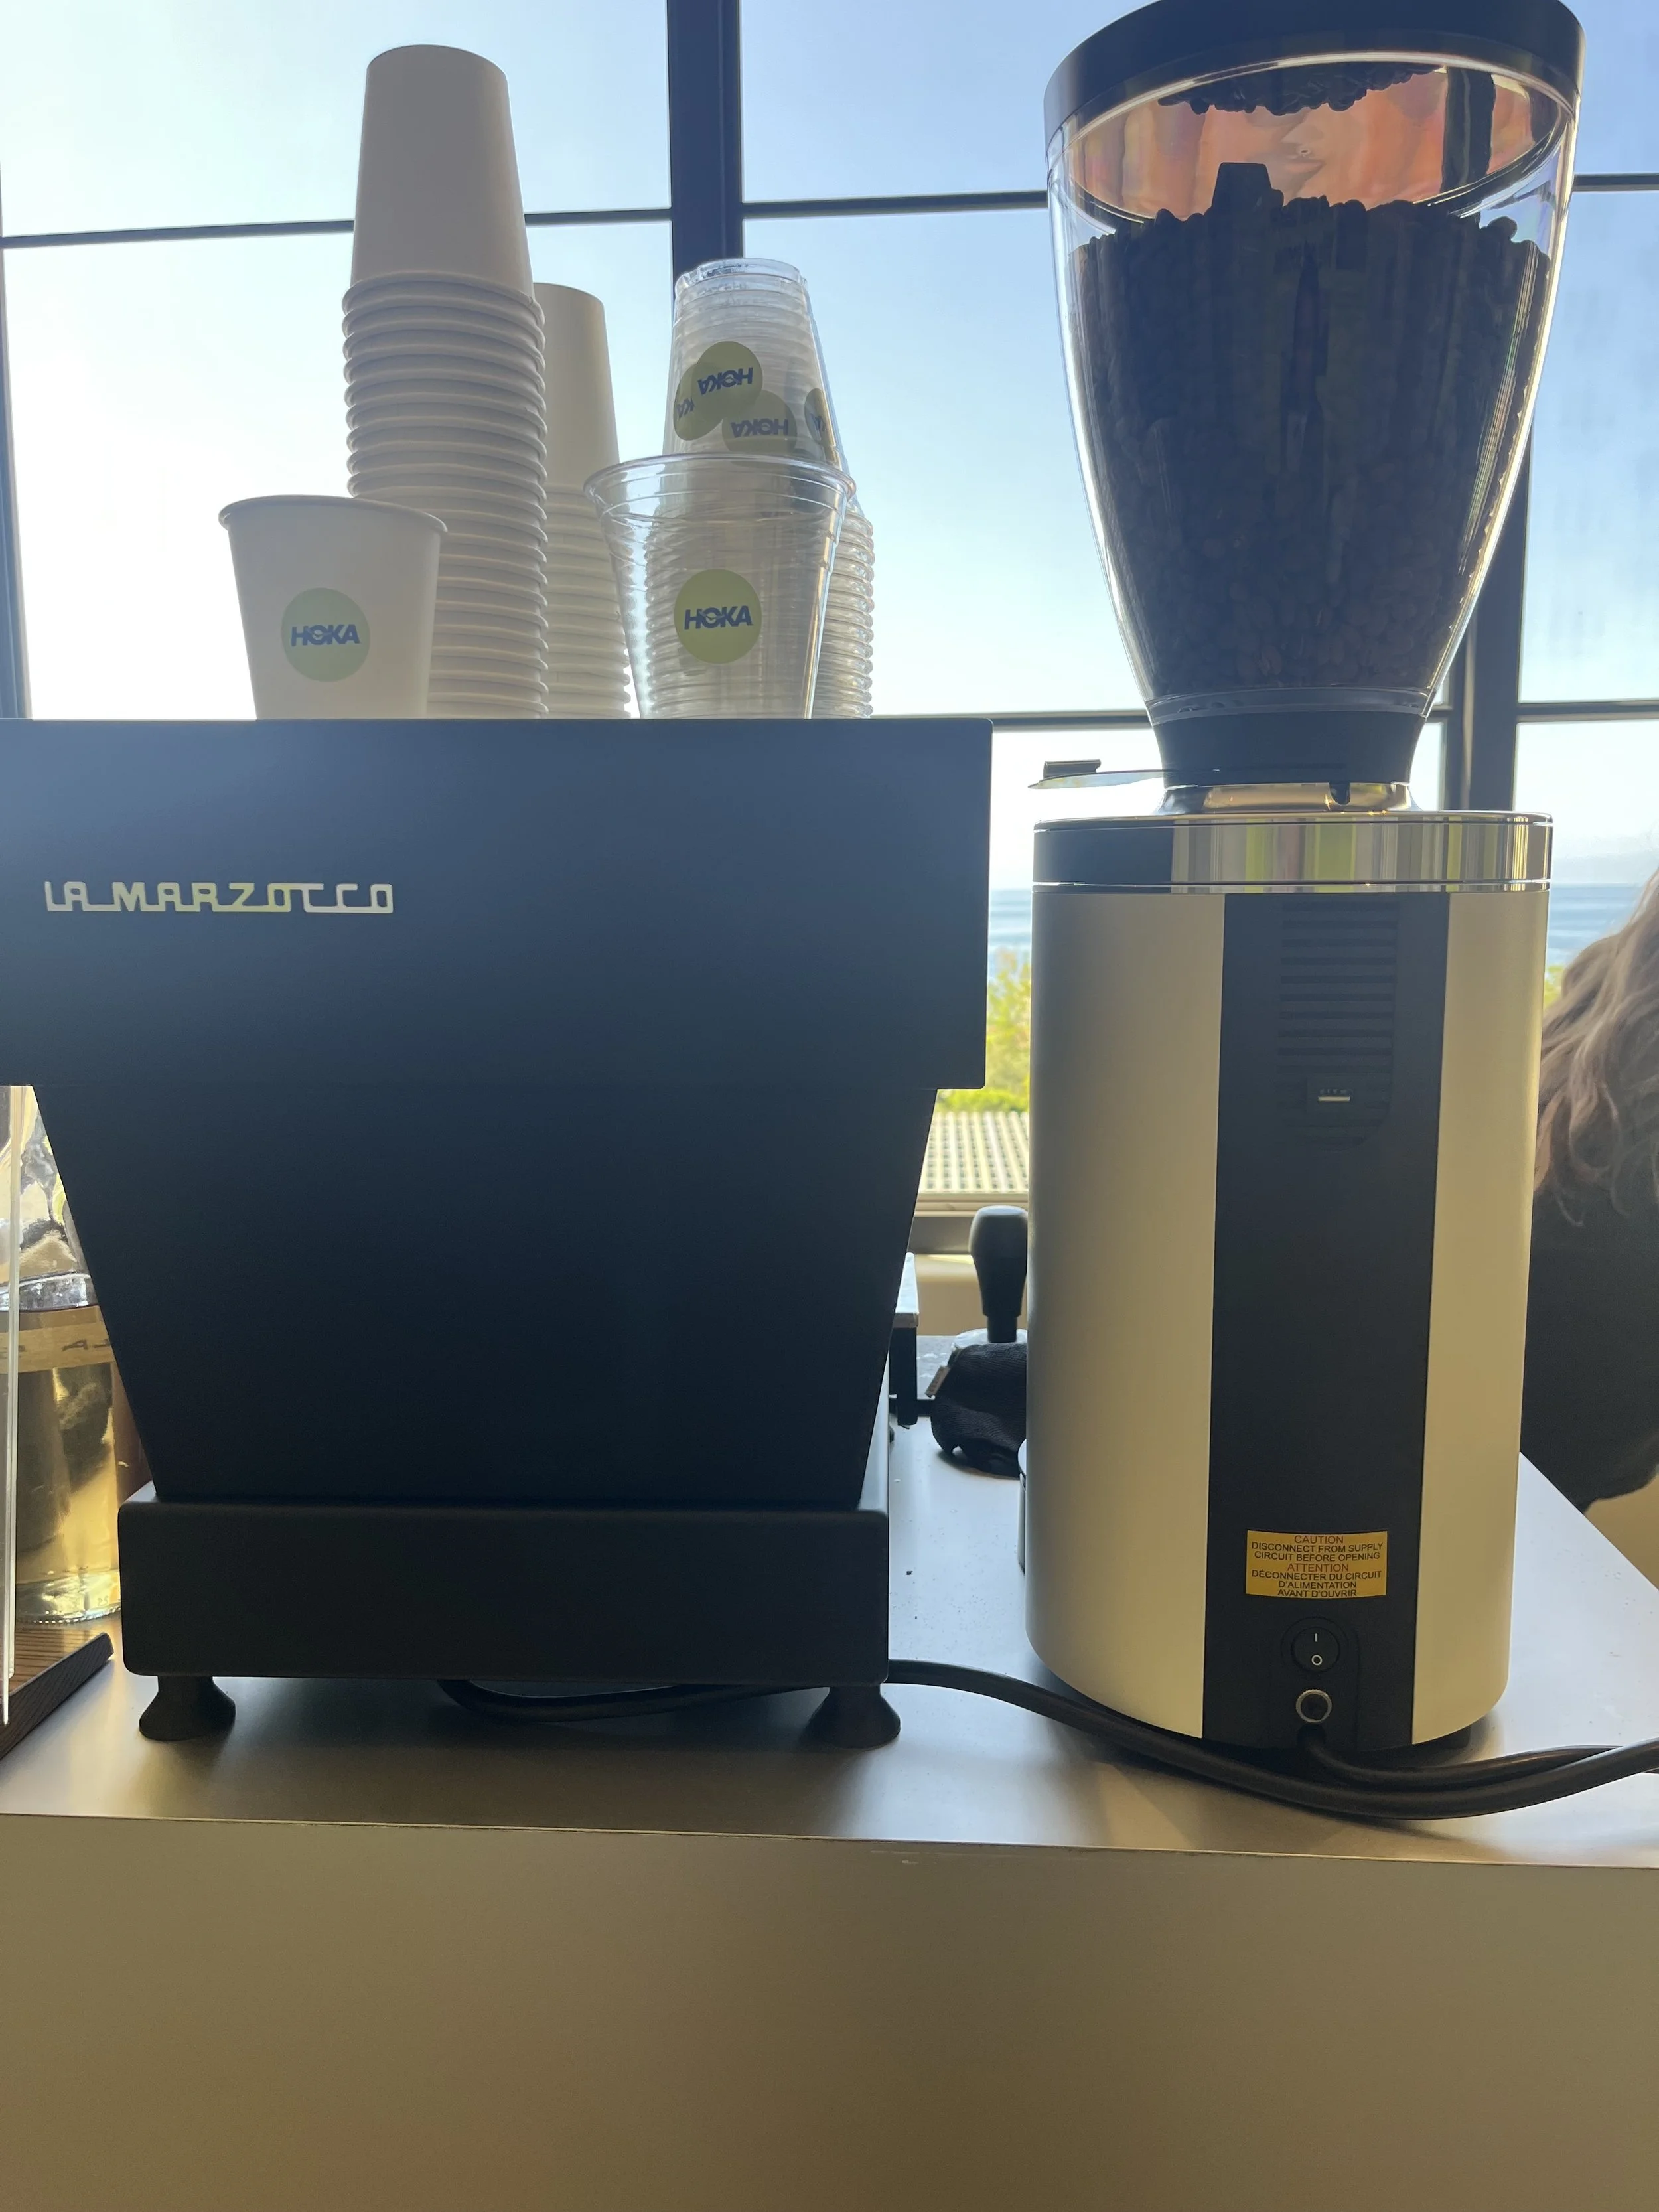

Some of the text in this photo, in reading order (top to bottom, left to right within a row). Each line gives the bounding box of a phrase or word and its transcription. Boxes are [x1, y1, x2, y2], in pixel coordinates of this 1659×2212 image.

[697, 367, 753, 395] HOKA
[730, 418, 788, 438] HOKA
[684, 605, 753, 630] HOKA
[291, 624, 360, 647] HOKA
[44, 881, 98, 911] LA
[1294, 1535, 1344, 1544] CAUTION
[1252, 1542, 1315, 1553] DISCONNECT
[1348, 1542, 1384, 1552] SUPPLY
[1254, 1551, 1293, 1561] CIRCUIT
[1338, 1552, 1380, 1561] OPENING
[1287, 1564, 1349, 1572] ATTENTION
[1252, 1569, 1326, 1581] DÉCONNECTER
[1345, 1570, 1382, 1580] CIRCUIT
[1311, 1589, 1357, 1598] D'OUVRIR
